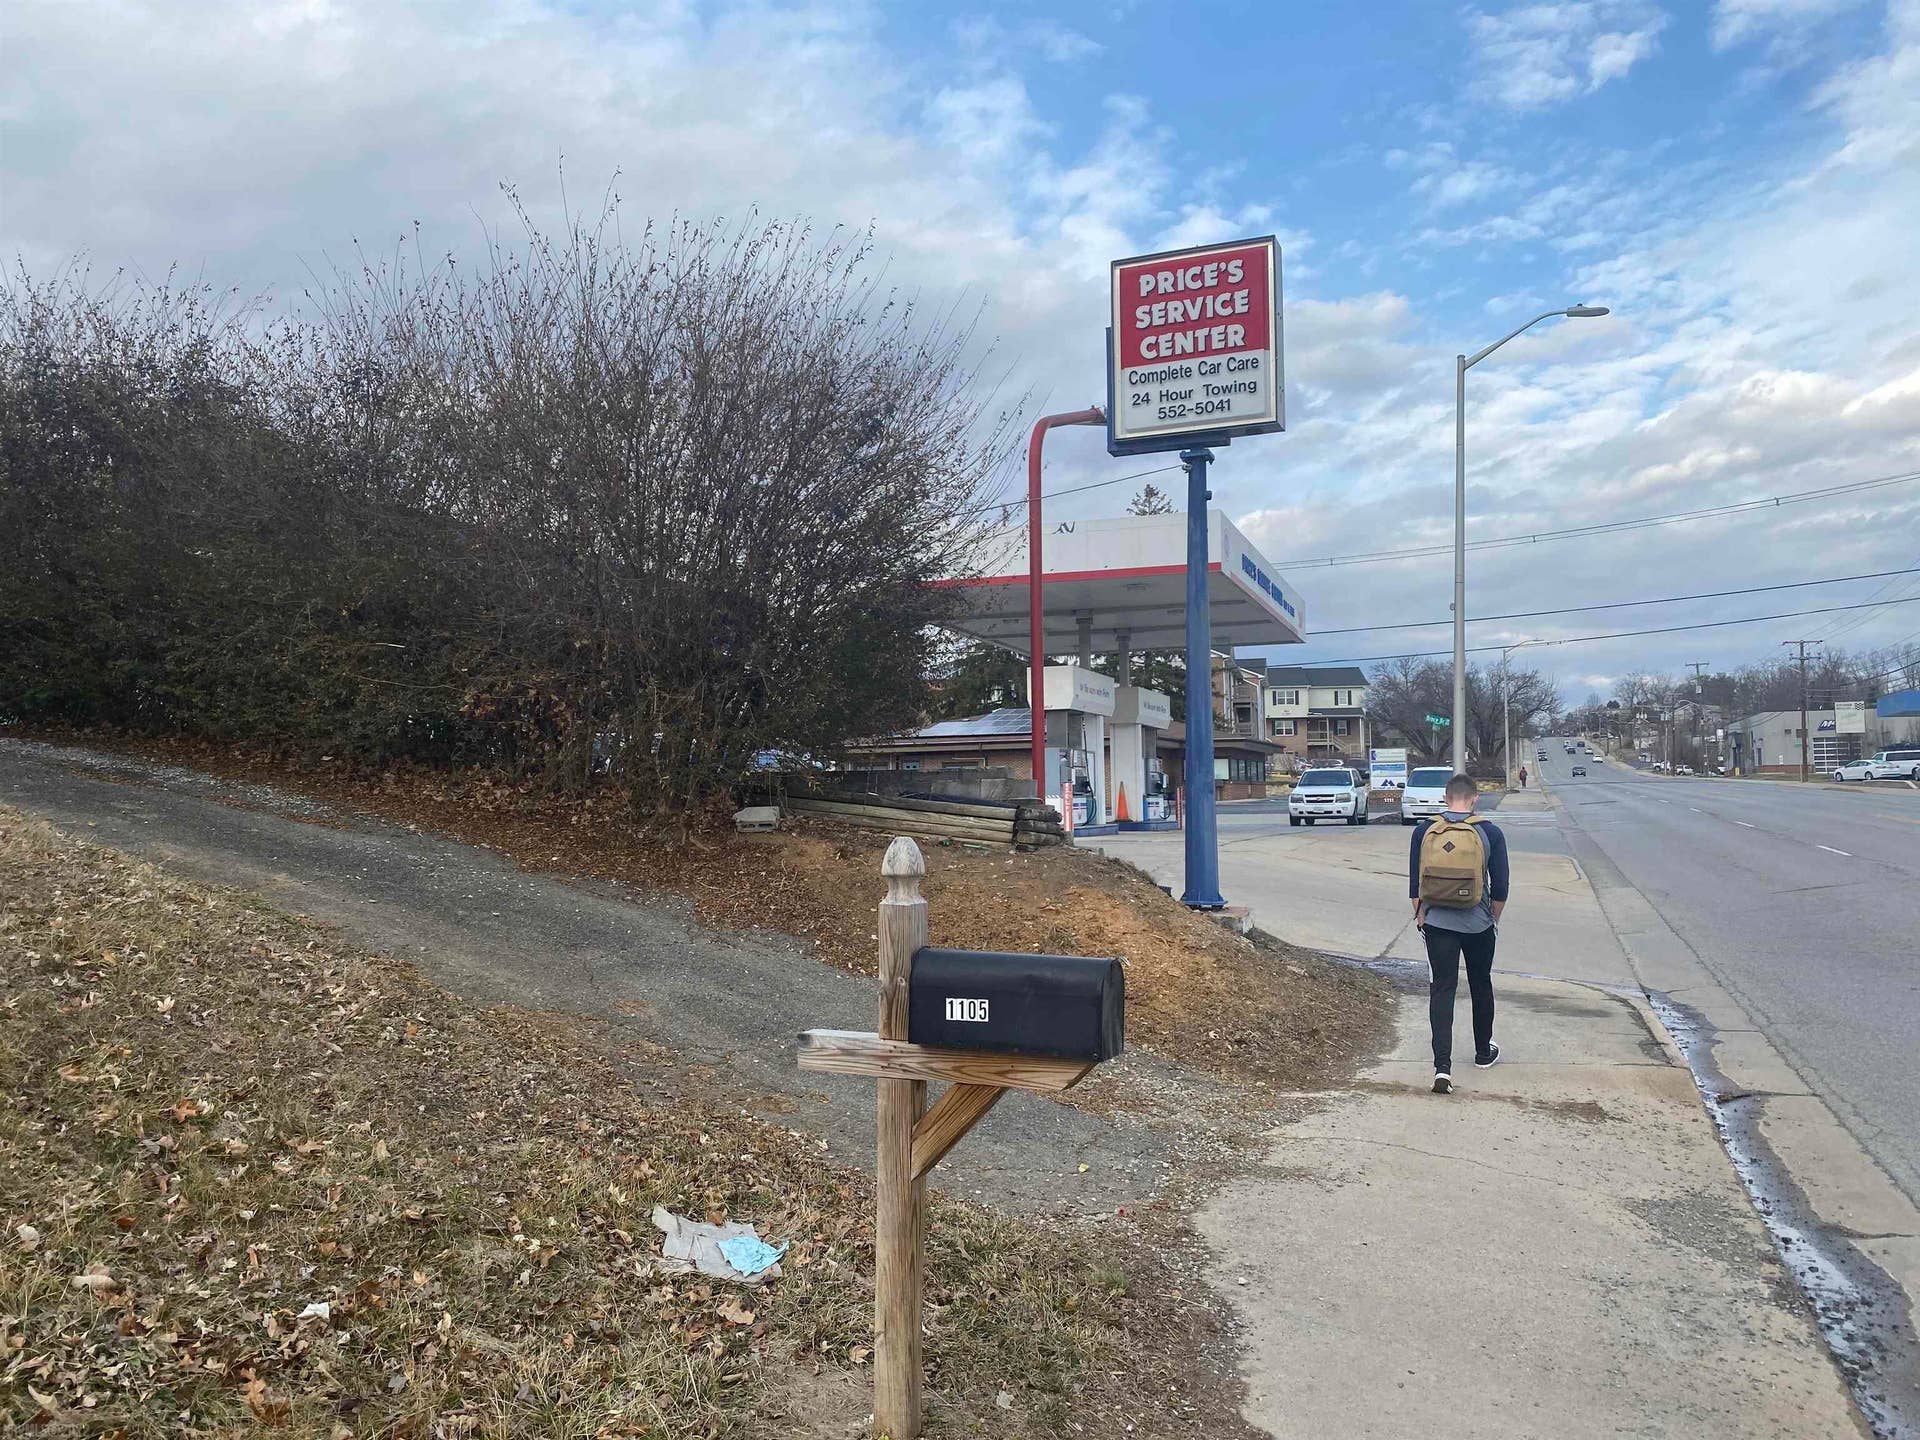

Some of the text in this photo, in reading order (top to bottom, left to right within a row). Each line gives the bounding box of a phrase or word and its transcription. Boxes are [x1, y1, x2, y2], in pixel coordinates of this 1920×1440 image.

[1139, 259, 1244, 297] PRICE'S
[1135, 289, 1249, 329] SERVICE
[1139, 324, 1246, 360] CENTER
[1128, 356, 1259, 385] Complete Car Care
[1132, 379, 1257, 407] 24 Hour Towing
[1158, 398, 1232, 420] 552-5041
[948, 1000, 987, 1020] 1105
